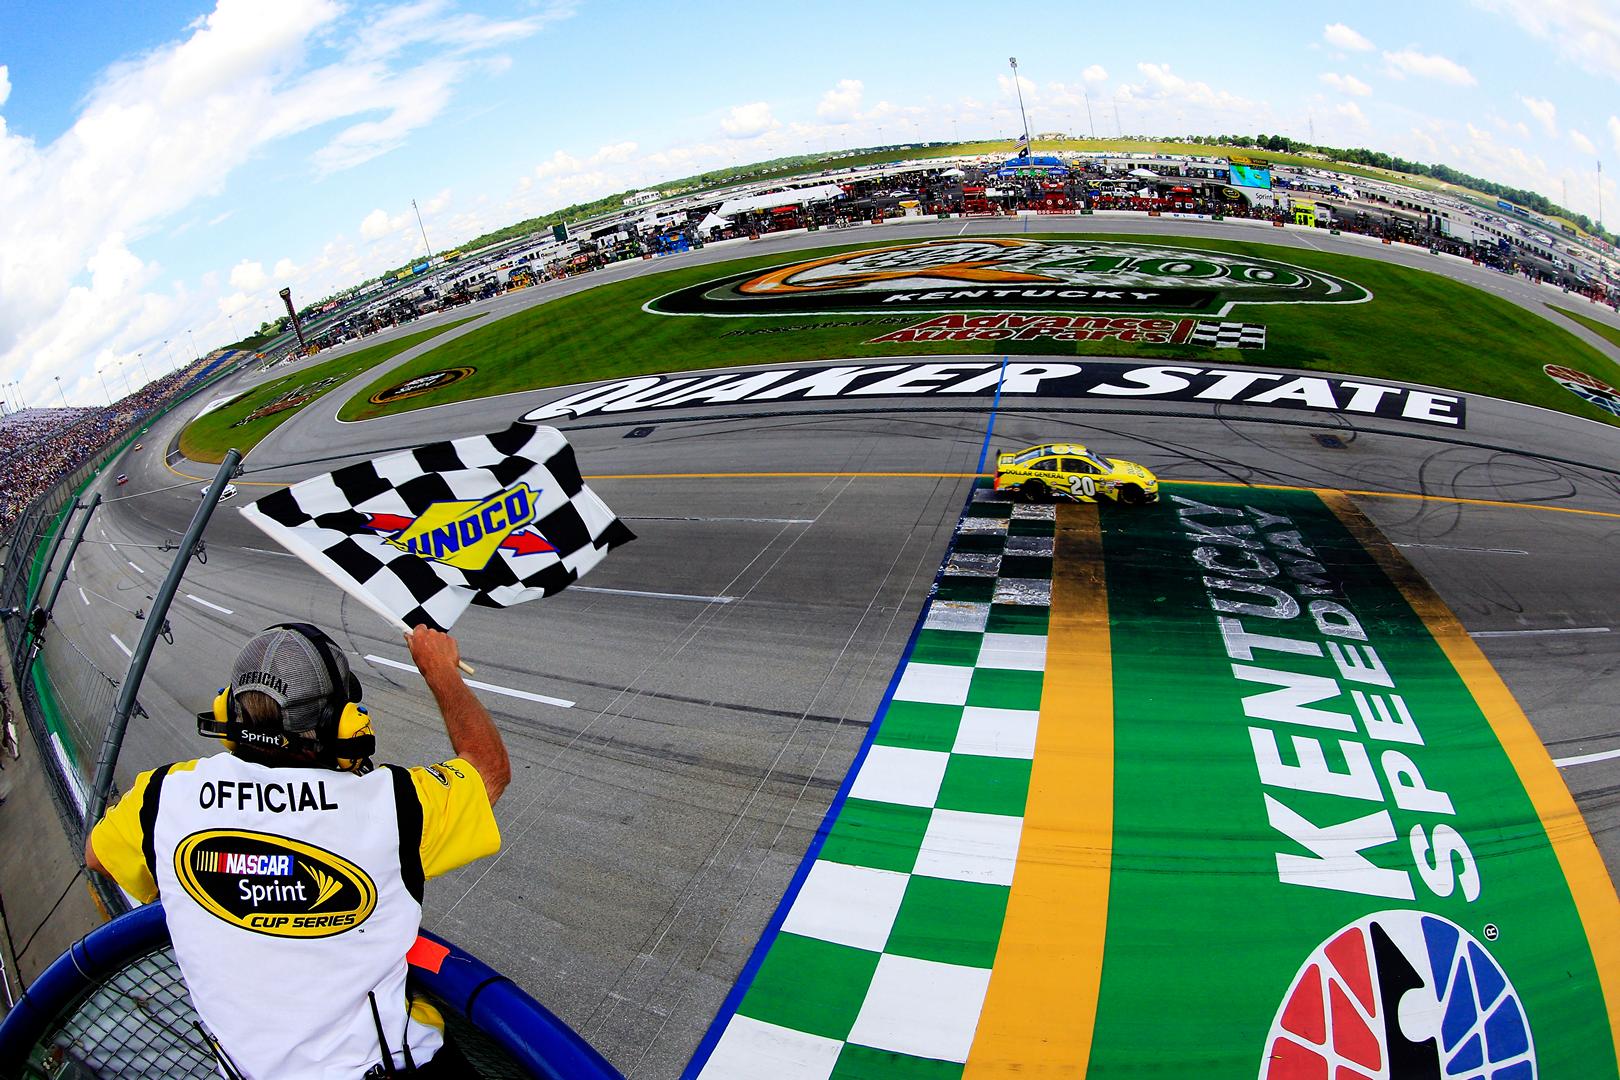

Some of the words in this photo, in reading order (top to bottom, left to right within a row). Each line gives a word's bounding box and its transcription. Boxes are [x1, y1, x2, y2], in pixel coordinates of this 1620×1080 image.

[886, 290, 1160, 302] KENTUCKY
[906, 314, 1175, 331] Advance
[863, 328, 1015, 343] Auto
[1012, 327, 1171, 343] Parts
[524, 363, 1082, 420] QUAKER
[1087, 366, 1459, 425] STATE
[1005, 469, 1033, 477] DOLLAR
[1034, 471, 1065, 480] GENERAL
[1067, 475, 1096, 497] 20
[398, 488, 530, 558] UNOCO
[238, 672, 290, 698] OFFICIAL
[1170, 494, 1416, 901] KENTUCKY
[241, 730, 281, 746] Sprint
[199, 780, 338, 814] OFFICIAL
[225, 853, 290, 876] NASCAR
[238, 878, 307, 907] Sprint
[250, 916, 290, 929] CUP
[292, 913, 357, 928] SERIES
